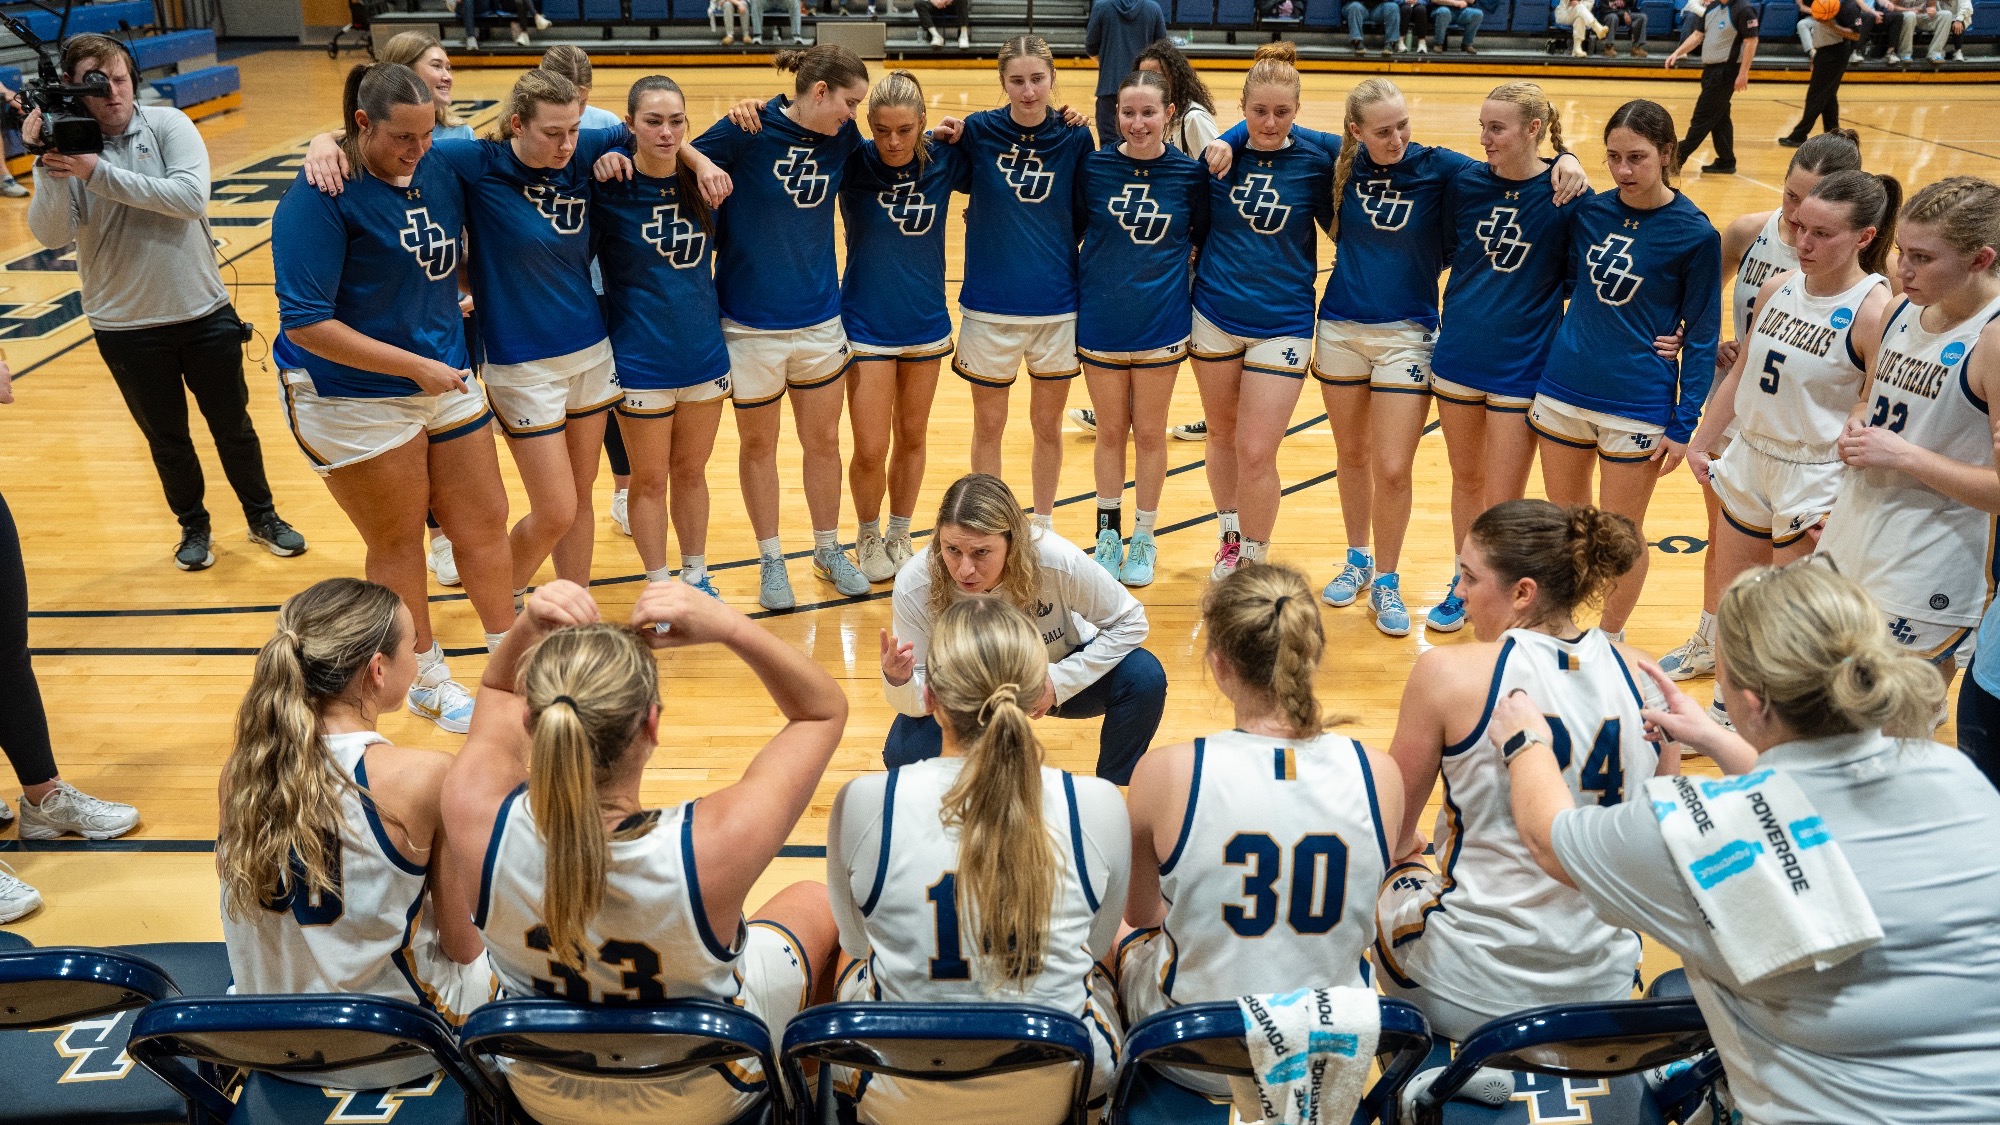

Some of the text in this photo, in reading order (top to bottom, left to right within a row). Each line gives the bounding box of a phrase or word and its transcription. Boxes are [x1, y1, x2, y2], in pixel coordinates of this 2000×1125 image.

[772, 146, 829, 208] JCU
[996, 144, 1055, 203] JCU
[1229, 174, 1292, 235] JCU
[641, 203, 706, 270] JCU
[877, 181, 936, 236] JCU
[1107, 183, 1172, 245] JCU
[1475, 206, 1532, 273] JCU
[399, 206, 457, 281] JCU
[1586, 232, 1644, 307] JCU
[1778, 317, 1838, 358] STREAKS
[1759, 348, 1787, 396] 5
[1892, 357, 1950, 401] STREAKS
[1746, 791, 1810, 895] POWERADE
[1221, 831, 1350, 939] 30
